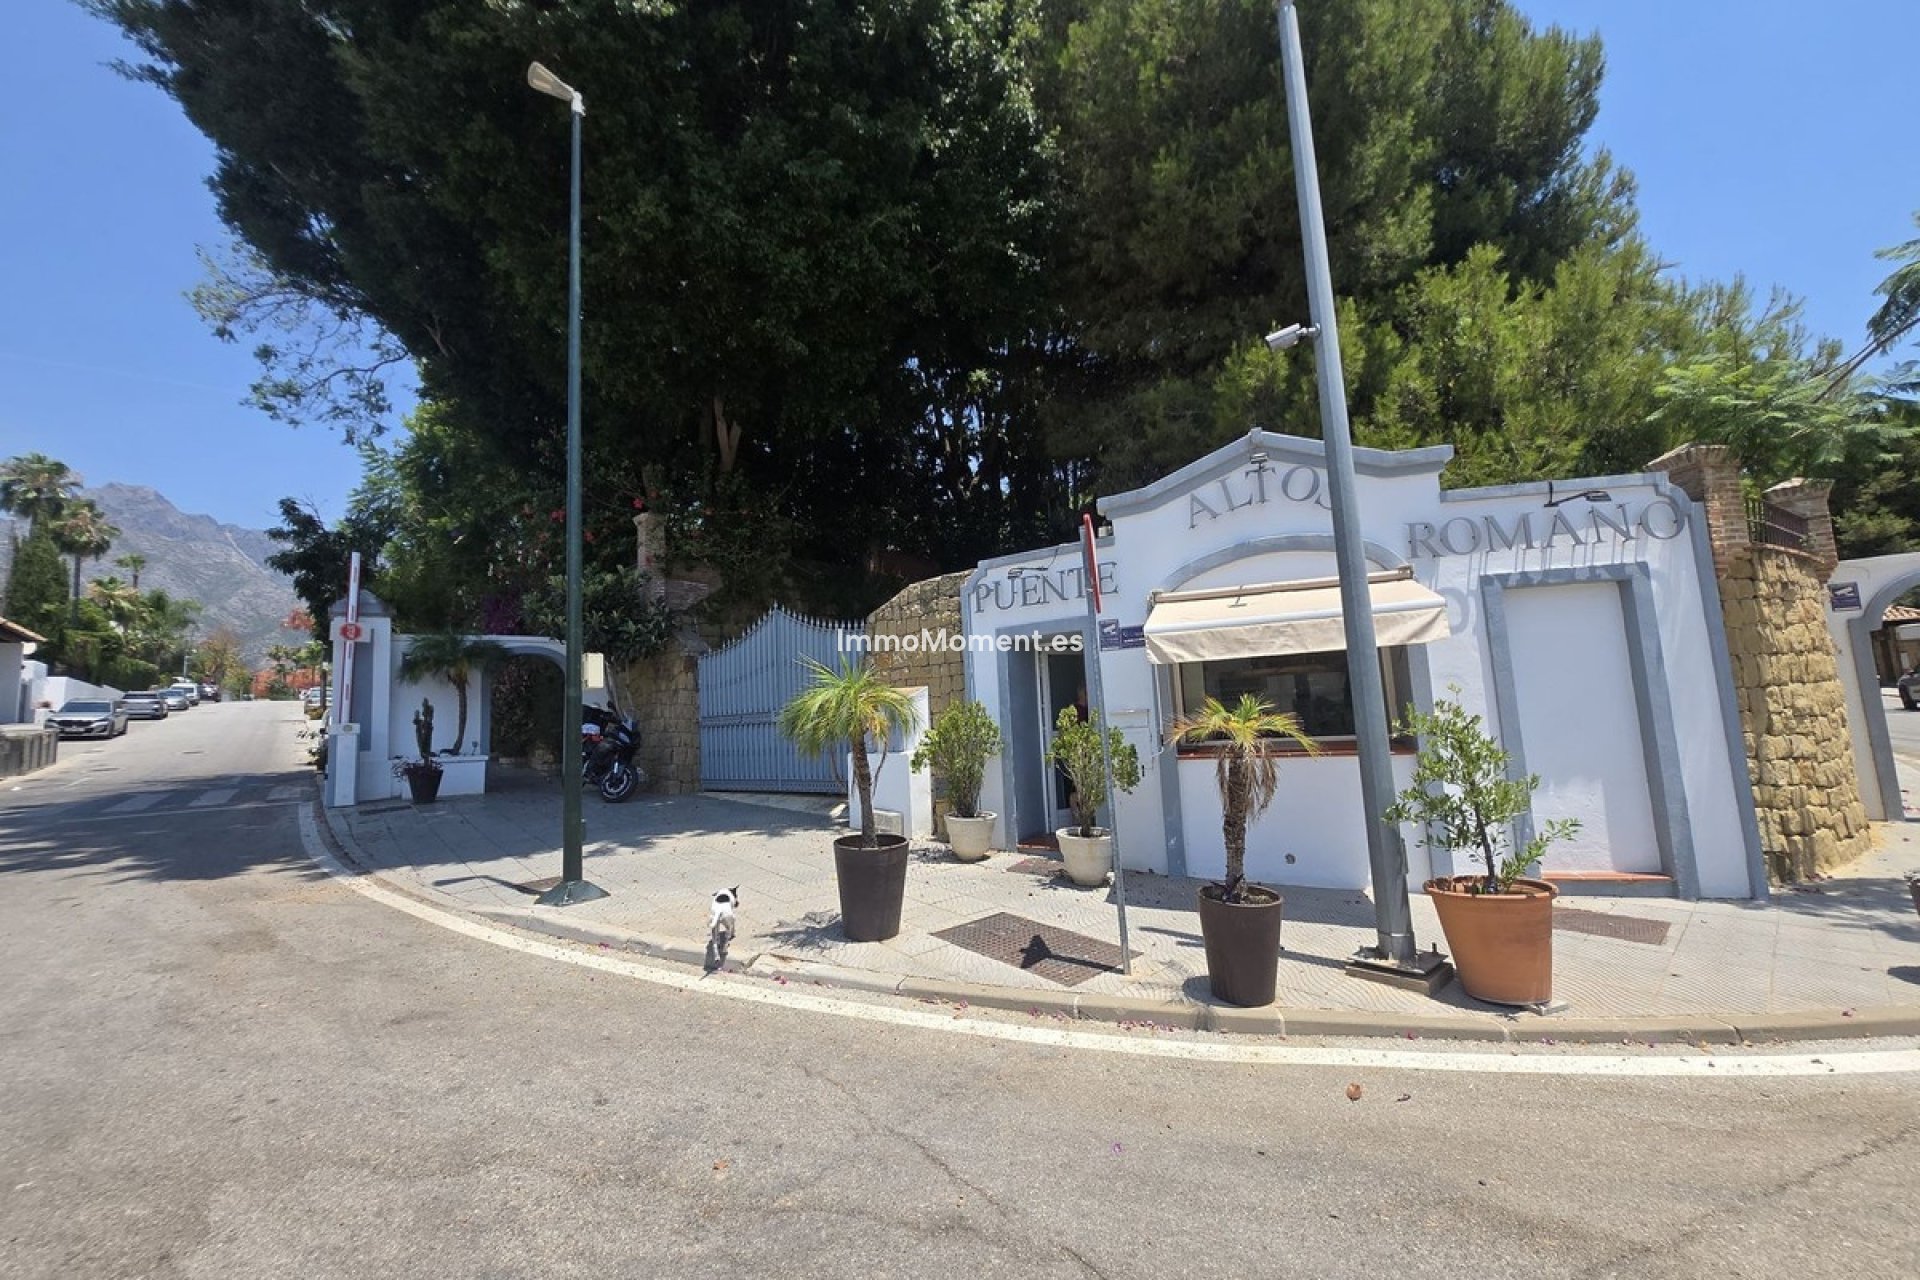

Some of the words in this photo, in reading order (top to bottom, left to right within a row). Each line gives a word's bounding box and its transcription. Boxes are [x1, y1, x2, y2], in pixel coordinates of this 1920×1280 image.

[1188, 464, 1333, 530] ALTO
[974, 561, 1119, 614] PUENTE
[1404, 500, 1684, 559] ROMANO
